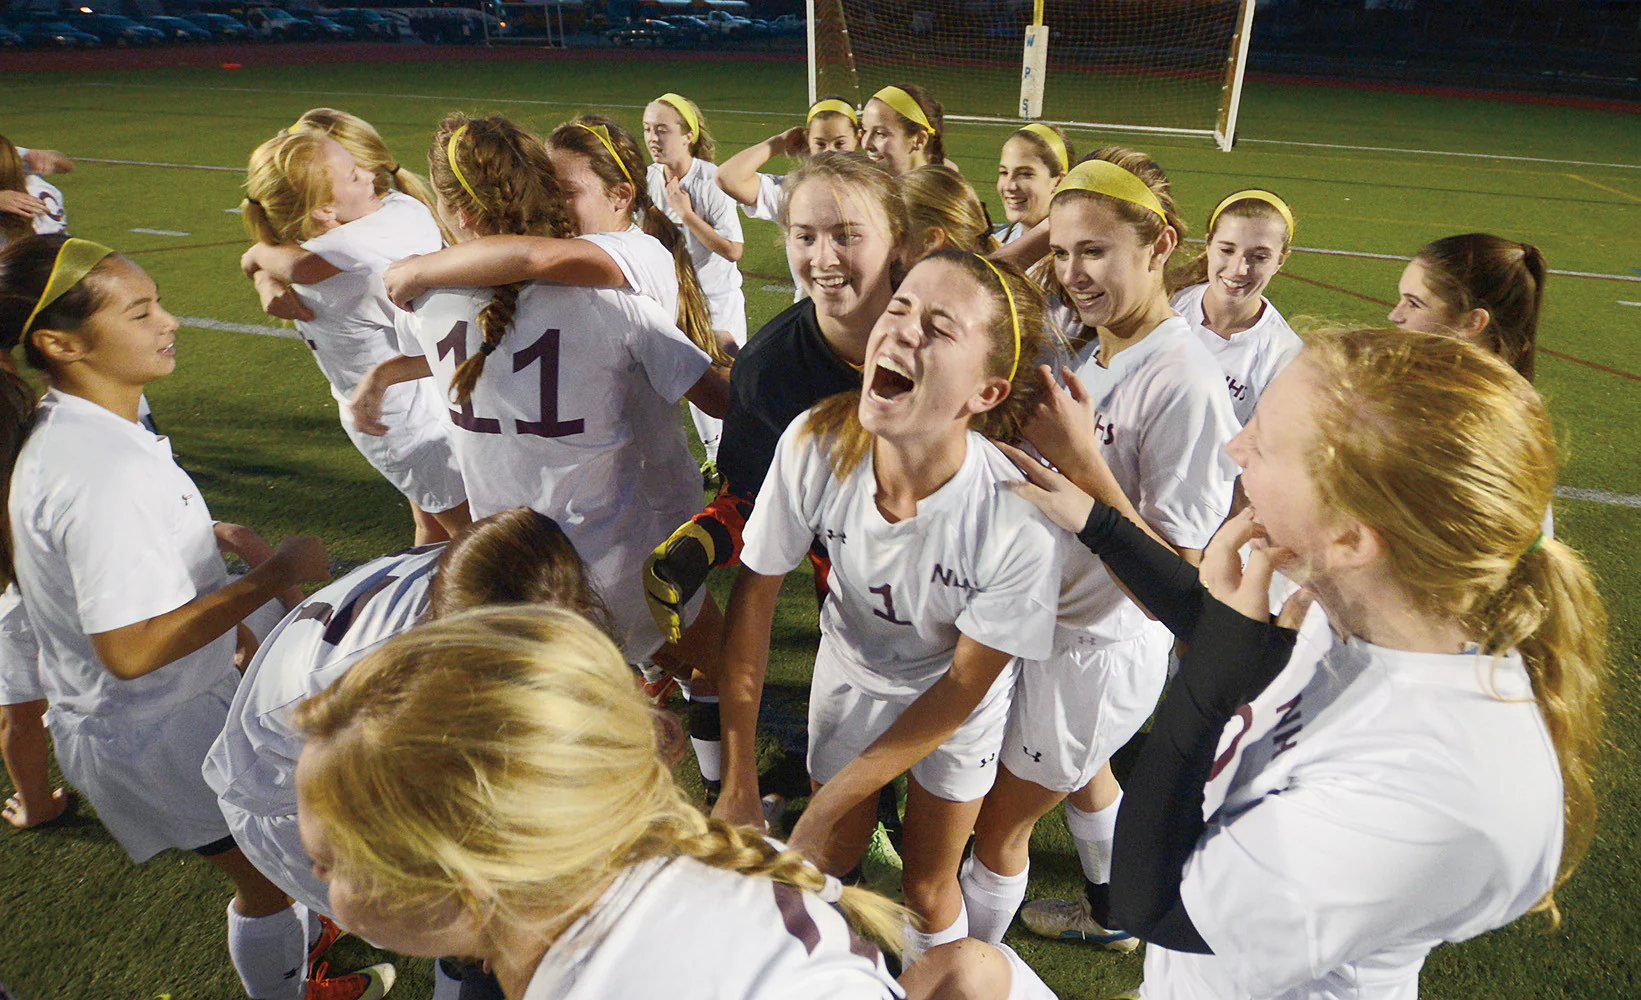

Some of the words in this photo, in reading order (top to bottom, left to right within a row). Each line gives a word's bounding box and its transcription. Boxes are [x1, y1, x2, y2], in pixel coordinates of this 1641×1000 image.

[436, 320, 585, 438] 11
[1094, 414, 1115, 445] HS
[868, 583, 913, 626] 1
